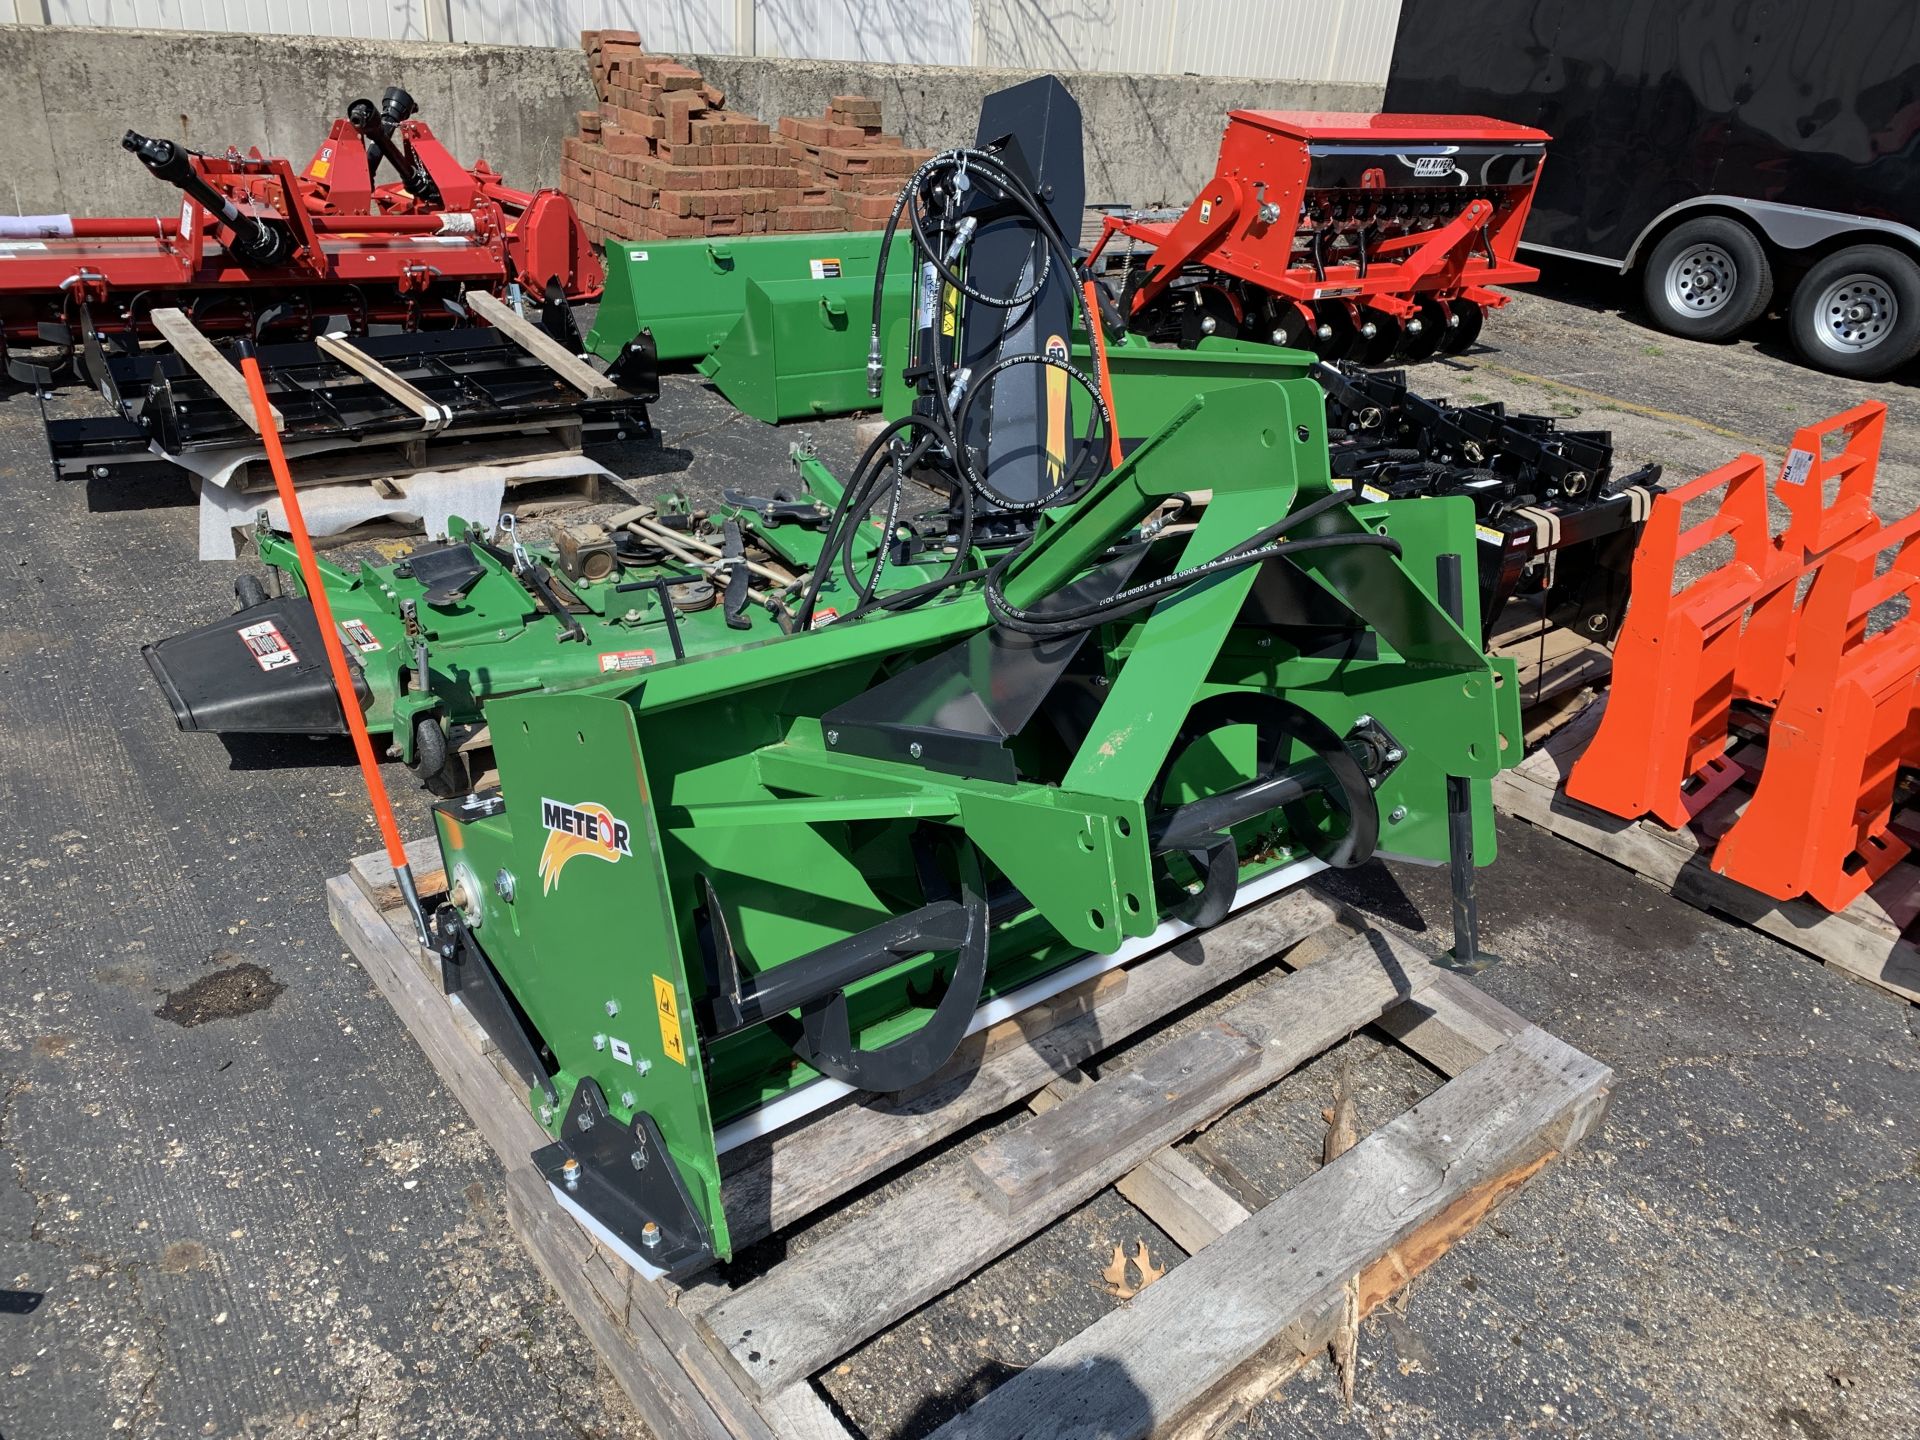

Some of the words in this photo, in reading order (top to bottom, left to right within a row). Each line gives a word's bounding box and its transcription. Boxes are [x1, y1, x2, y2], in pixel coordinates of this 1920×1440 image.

[1431, 159, 1453, 168] RIVER
[1068, 365, 1078, 375] PSI
[1782, 465, 1792, 480] HLA
[1242, 547, 1259, 558] R17
[1261, 542, 1278, 554] SAE
[1164, 573, 1178, 583] PSI
[1179, 567, 1198, 578] 3000
[1116, 591, 1127, 600] PSI
[1128, 584, 1147, 596] 12000
[544, 803, 628, 852] METEOR
